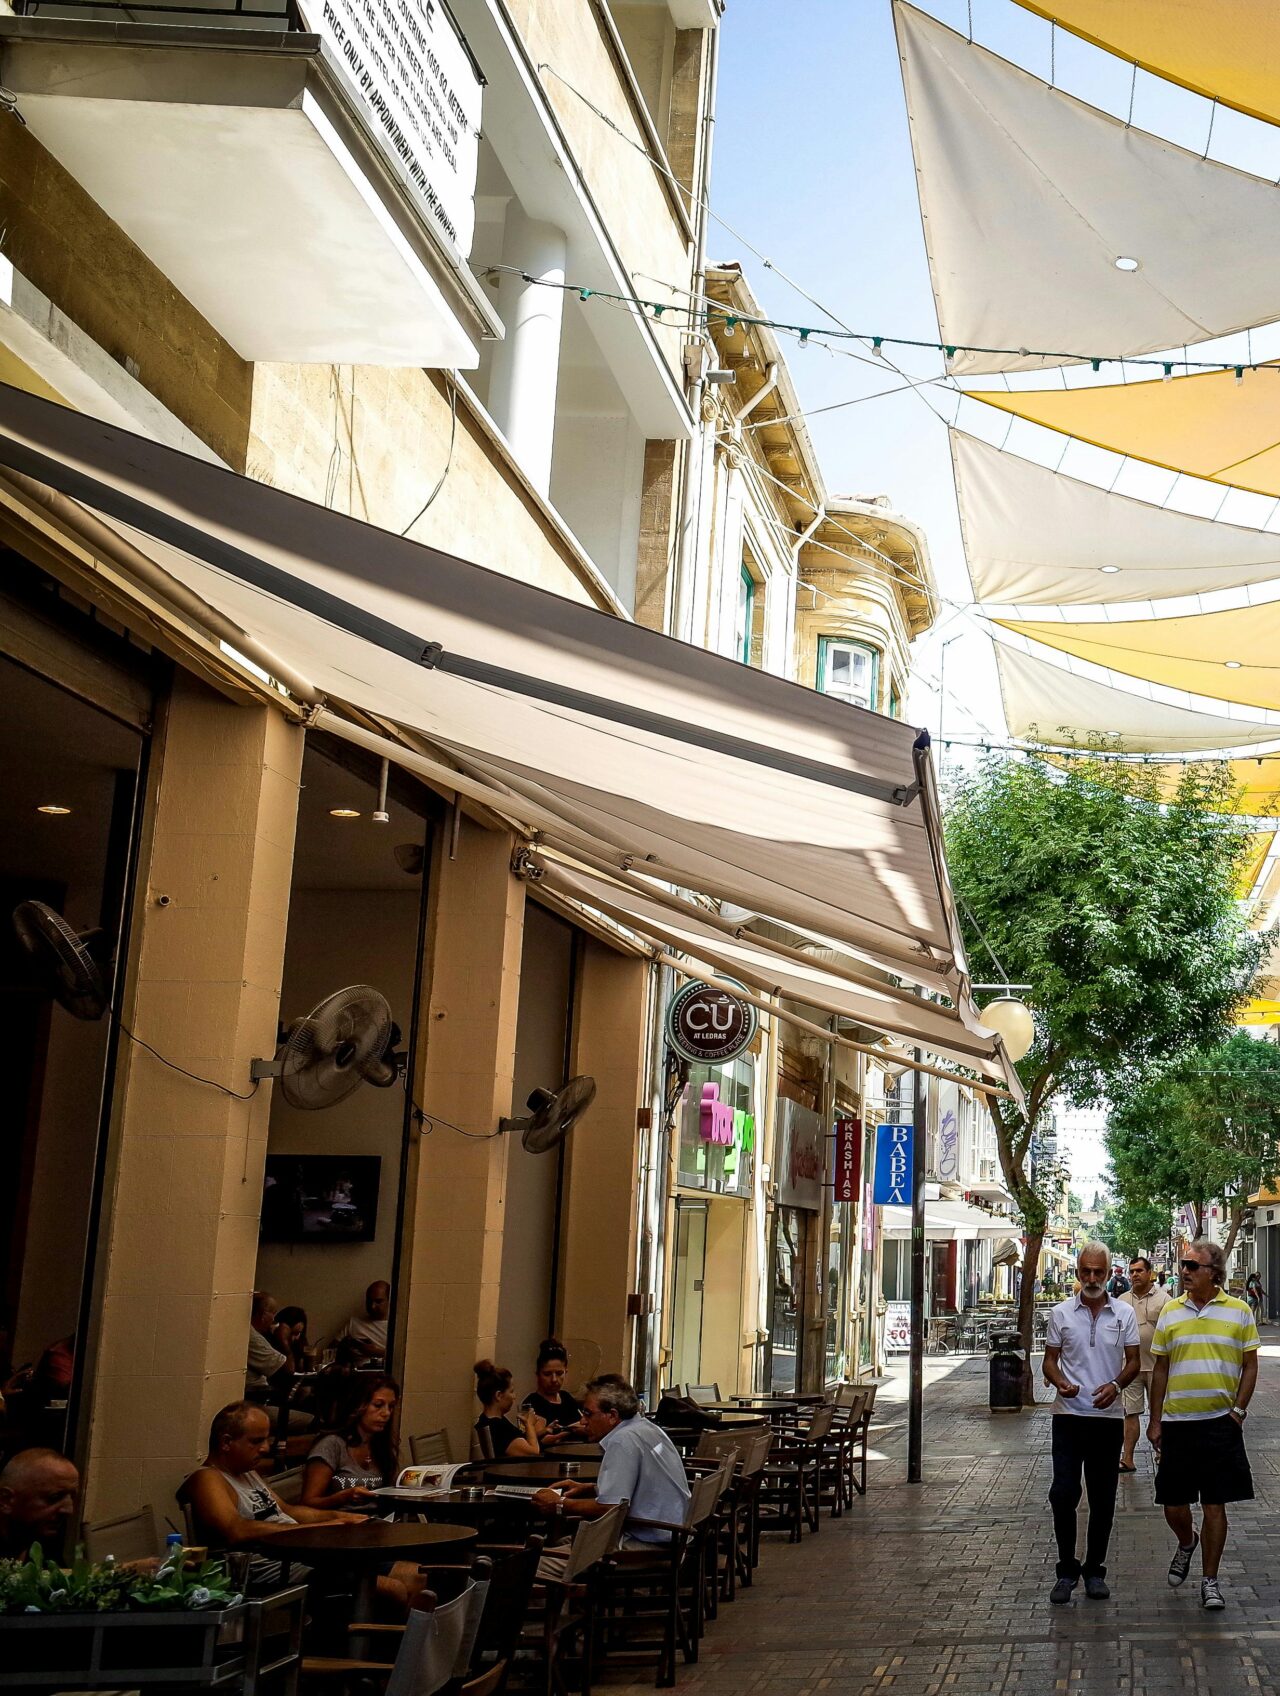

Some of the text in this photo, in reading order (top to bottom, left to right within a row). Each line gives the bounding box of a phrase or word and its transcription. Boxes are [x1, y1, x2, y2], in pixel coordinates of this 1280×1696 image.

[370, 41, 390, 87] HOTEL
[391, 79, 400, 99] OR
[383, 0, 399, 39] BOTH
[400, 32, 424, 85] STREETS
[323, 0, 346, 46] PRICE
[343, 39, 364, 76] ONLY
[360, 69, 374, 92] BY
[369, 88, 413, 164] APPOINTMENT
[409, 157, 427, 191] WITH
[423, 182, 438, 209] THE
[363, 0, 457, 174] THE UPPER TWO FLOORS ARE IDEAL
[427, 48, 440, 79] 1050
[448, 89, 468, 133] METERS
[678, 1033, 697, 1055] MEETING
[704, 1049, 729, 1058] COFFEE
[727, 1034, 746, 1052] PLACE
[842, 1122, 854, 1198] KRASHIAS
